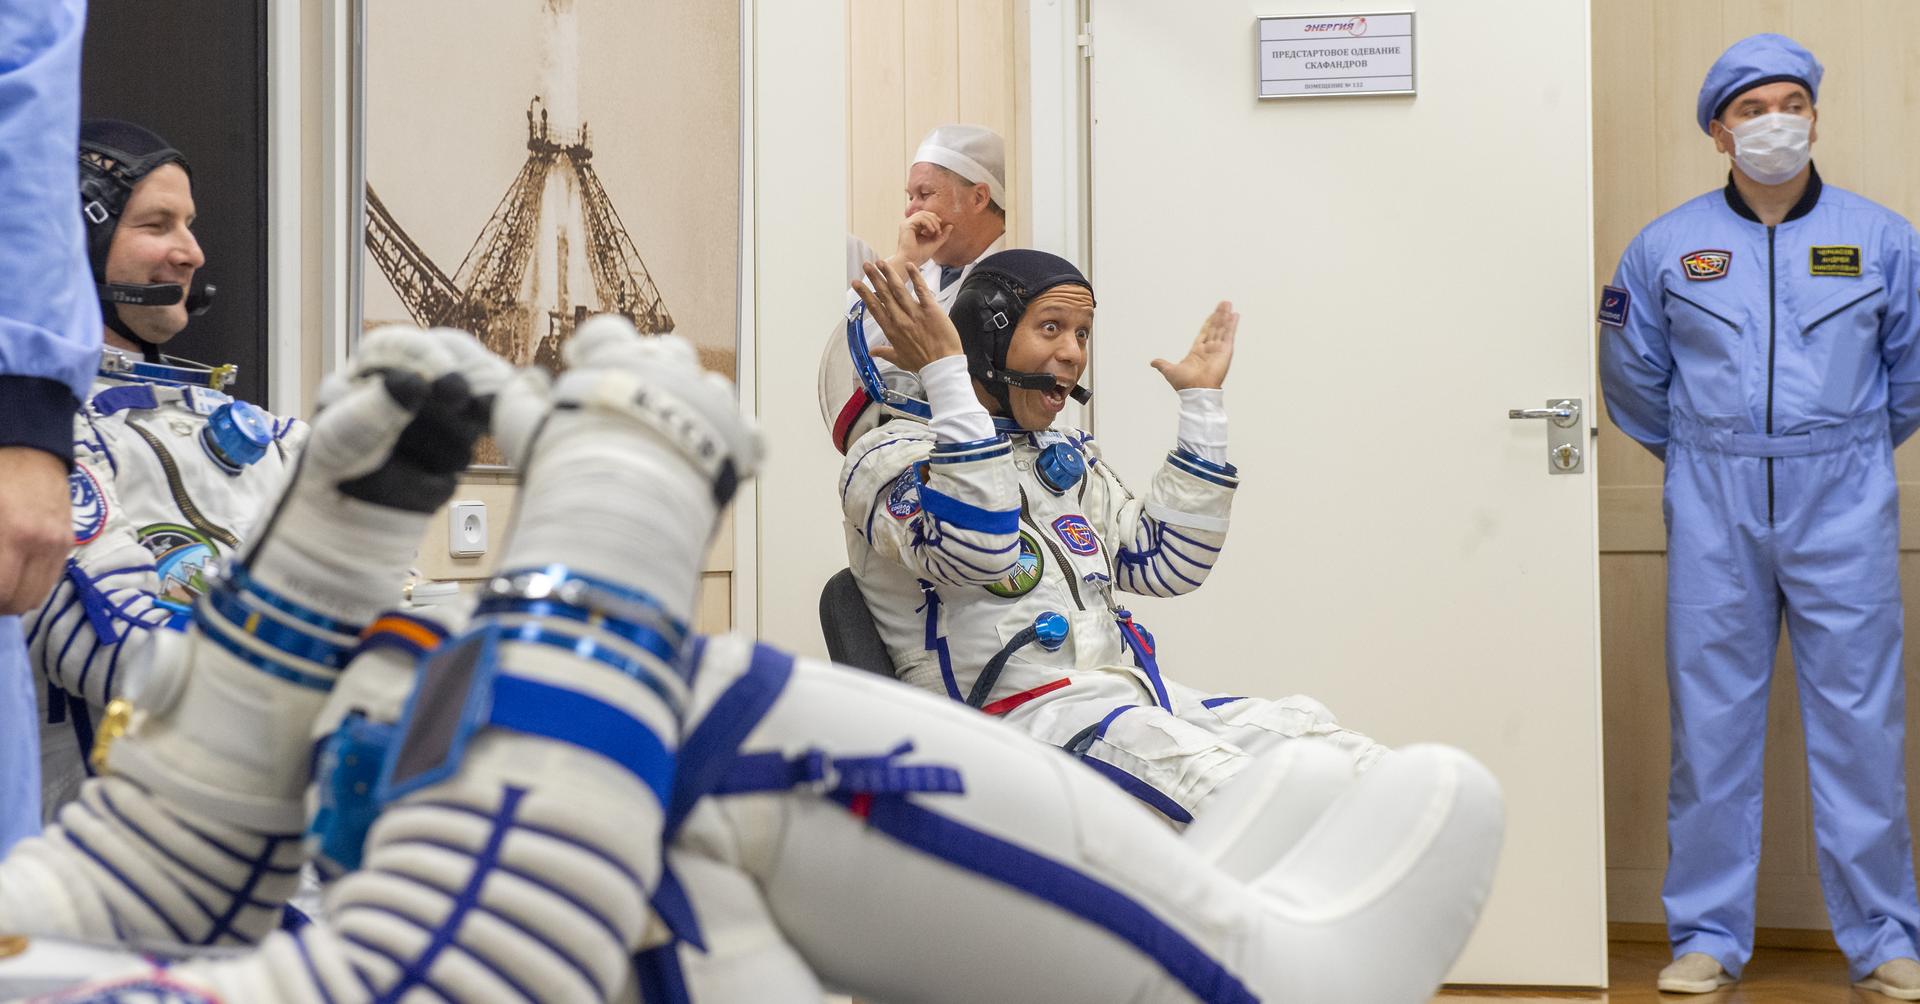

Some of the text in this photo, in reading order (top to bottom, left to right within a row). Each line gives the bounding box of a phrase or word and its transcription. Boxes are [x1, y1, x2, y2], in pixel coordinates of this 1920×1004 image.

[1304, 23, 1354, 32] ЭНЕРГИЯ
[1272, 46, 1401, 59] ПРЕДСТАРТОВОЕ ОДЕВАНИЕ
[1305, 60, 1368, 70] СКАФАНДРОВ
